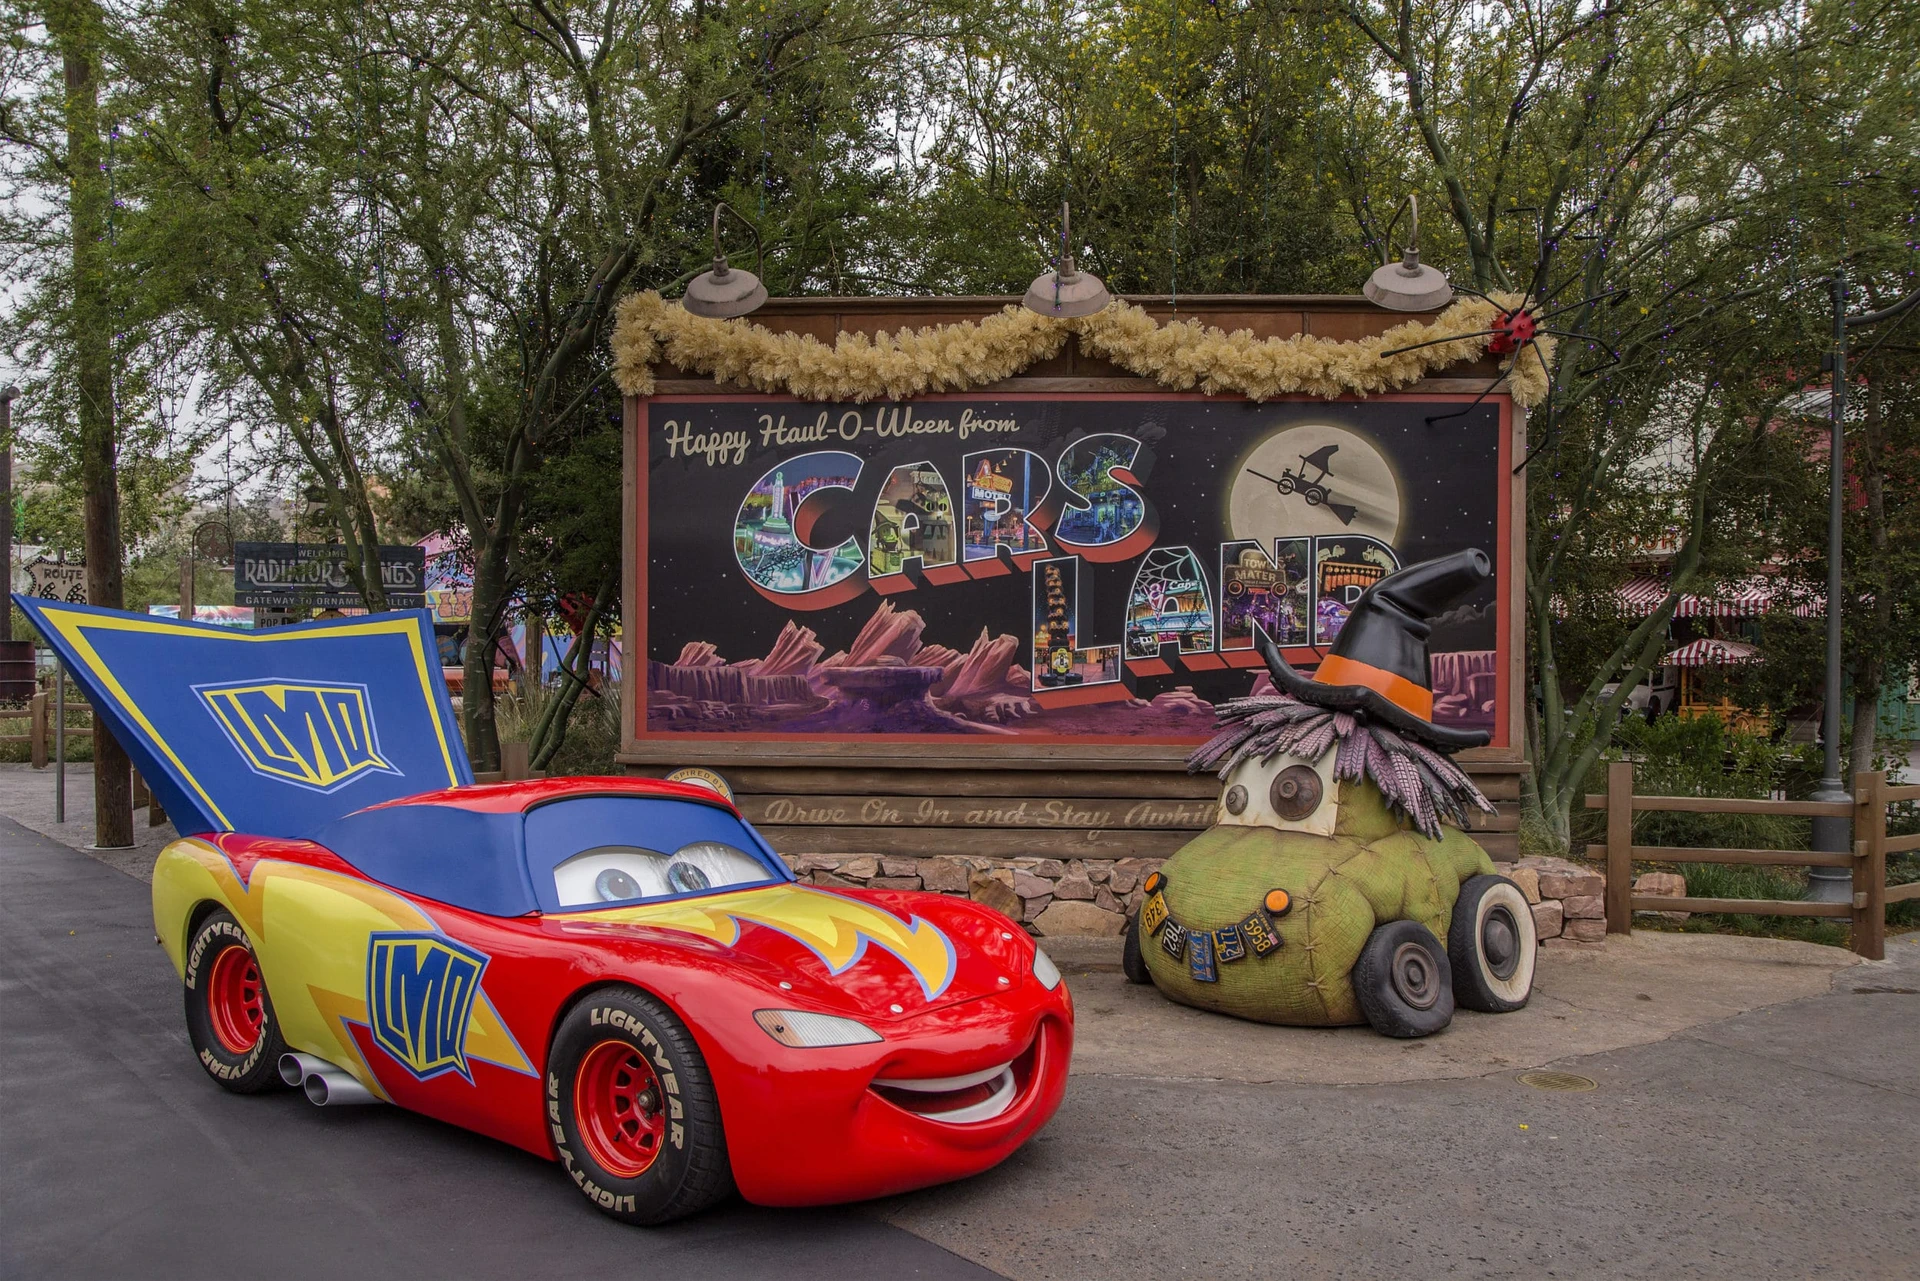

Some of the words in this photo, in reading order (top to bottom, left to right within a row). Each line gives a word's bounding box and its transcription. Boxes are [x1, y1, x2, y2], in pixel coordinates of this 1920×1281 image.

[664, 419, 750, 466] Happy
[959, 408, 1020, 440] from
[733, 432, 1146, 594] CARS
[973, 487, 1011, 501] MOTEL
[43, 568, 84, 580] ROUTE
[1234, 569, 1277, 582] MATER
[245, 596, 295, 605] GATEWAY
[300, 597, 312, 606] TO
[316, 597, 361, 606] ORNAME
[385, 598, 416, 606] ALLEY
[1031, 534, 1402, 693] LAND
[673, 769, 711, 780] SPIRED
[712, 778, 724, 789] BY
[860, 799, 903, 824] On
[913, 798, 954, 824] In
[963, 802, 1028, 826] and
[1036, 800, 1115, 841] Stay
[1145, 900, 1162, 928] 349
[1163, 921, 1182, 952] 782
[1244, 918, 1271, 953] 5958
[186, 921, 252, 990] LIGHTYEAR
[200, 1011, 269, 1080] LIGHTYEAR
[591, 1007, 684, 1150] LIGHTYEAR
[549, 1071, 636, 1213] LIGHTYEAR
